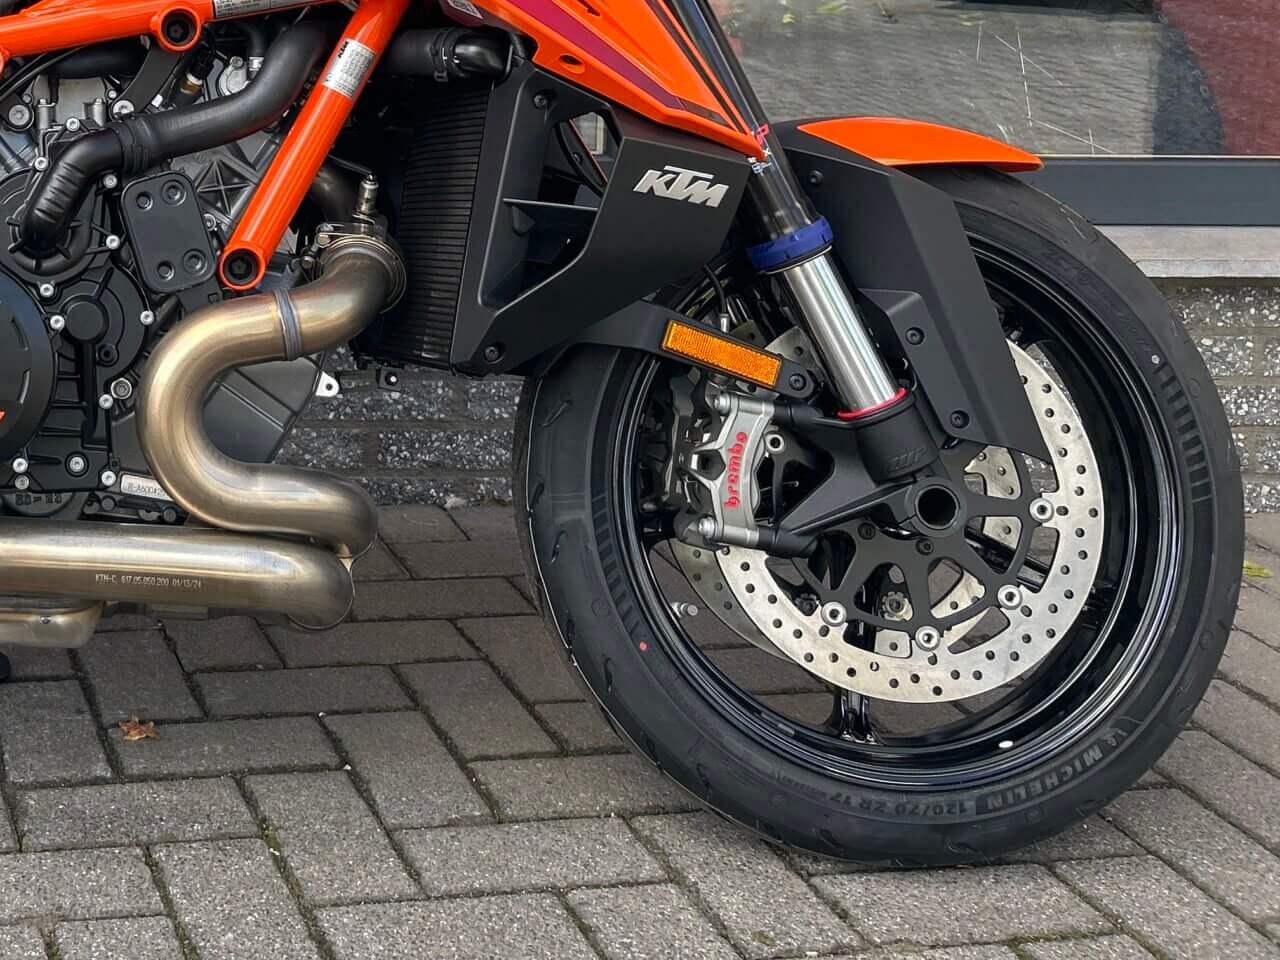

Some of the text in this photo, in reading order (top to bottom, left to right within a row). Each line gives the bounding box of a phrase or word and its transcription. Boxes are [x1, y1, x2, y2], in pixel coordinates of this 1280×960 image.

[633, 165, 729, 208] KTM
[724, 431, 749, 509] brembo
[986, 743, 1103, 811] MICHELIN
[895, 800, 967, 817] 120/70
